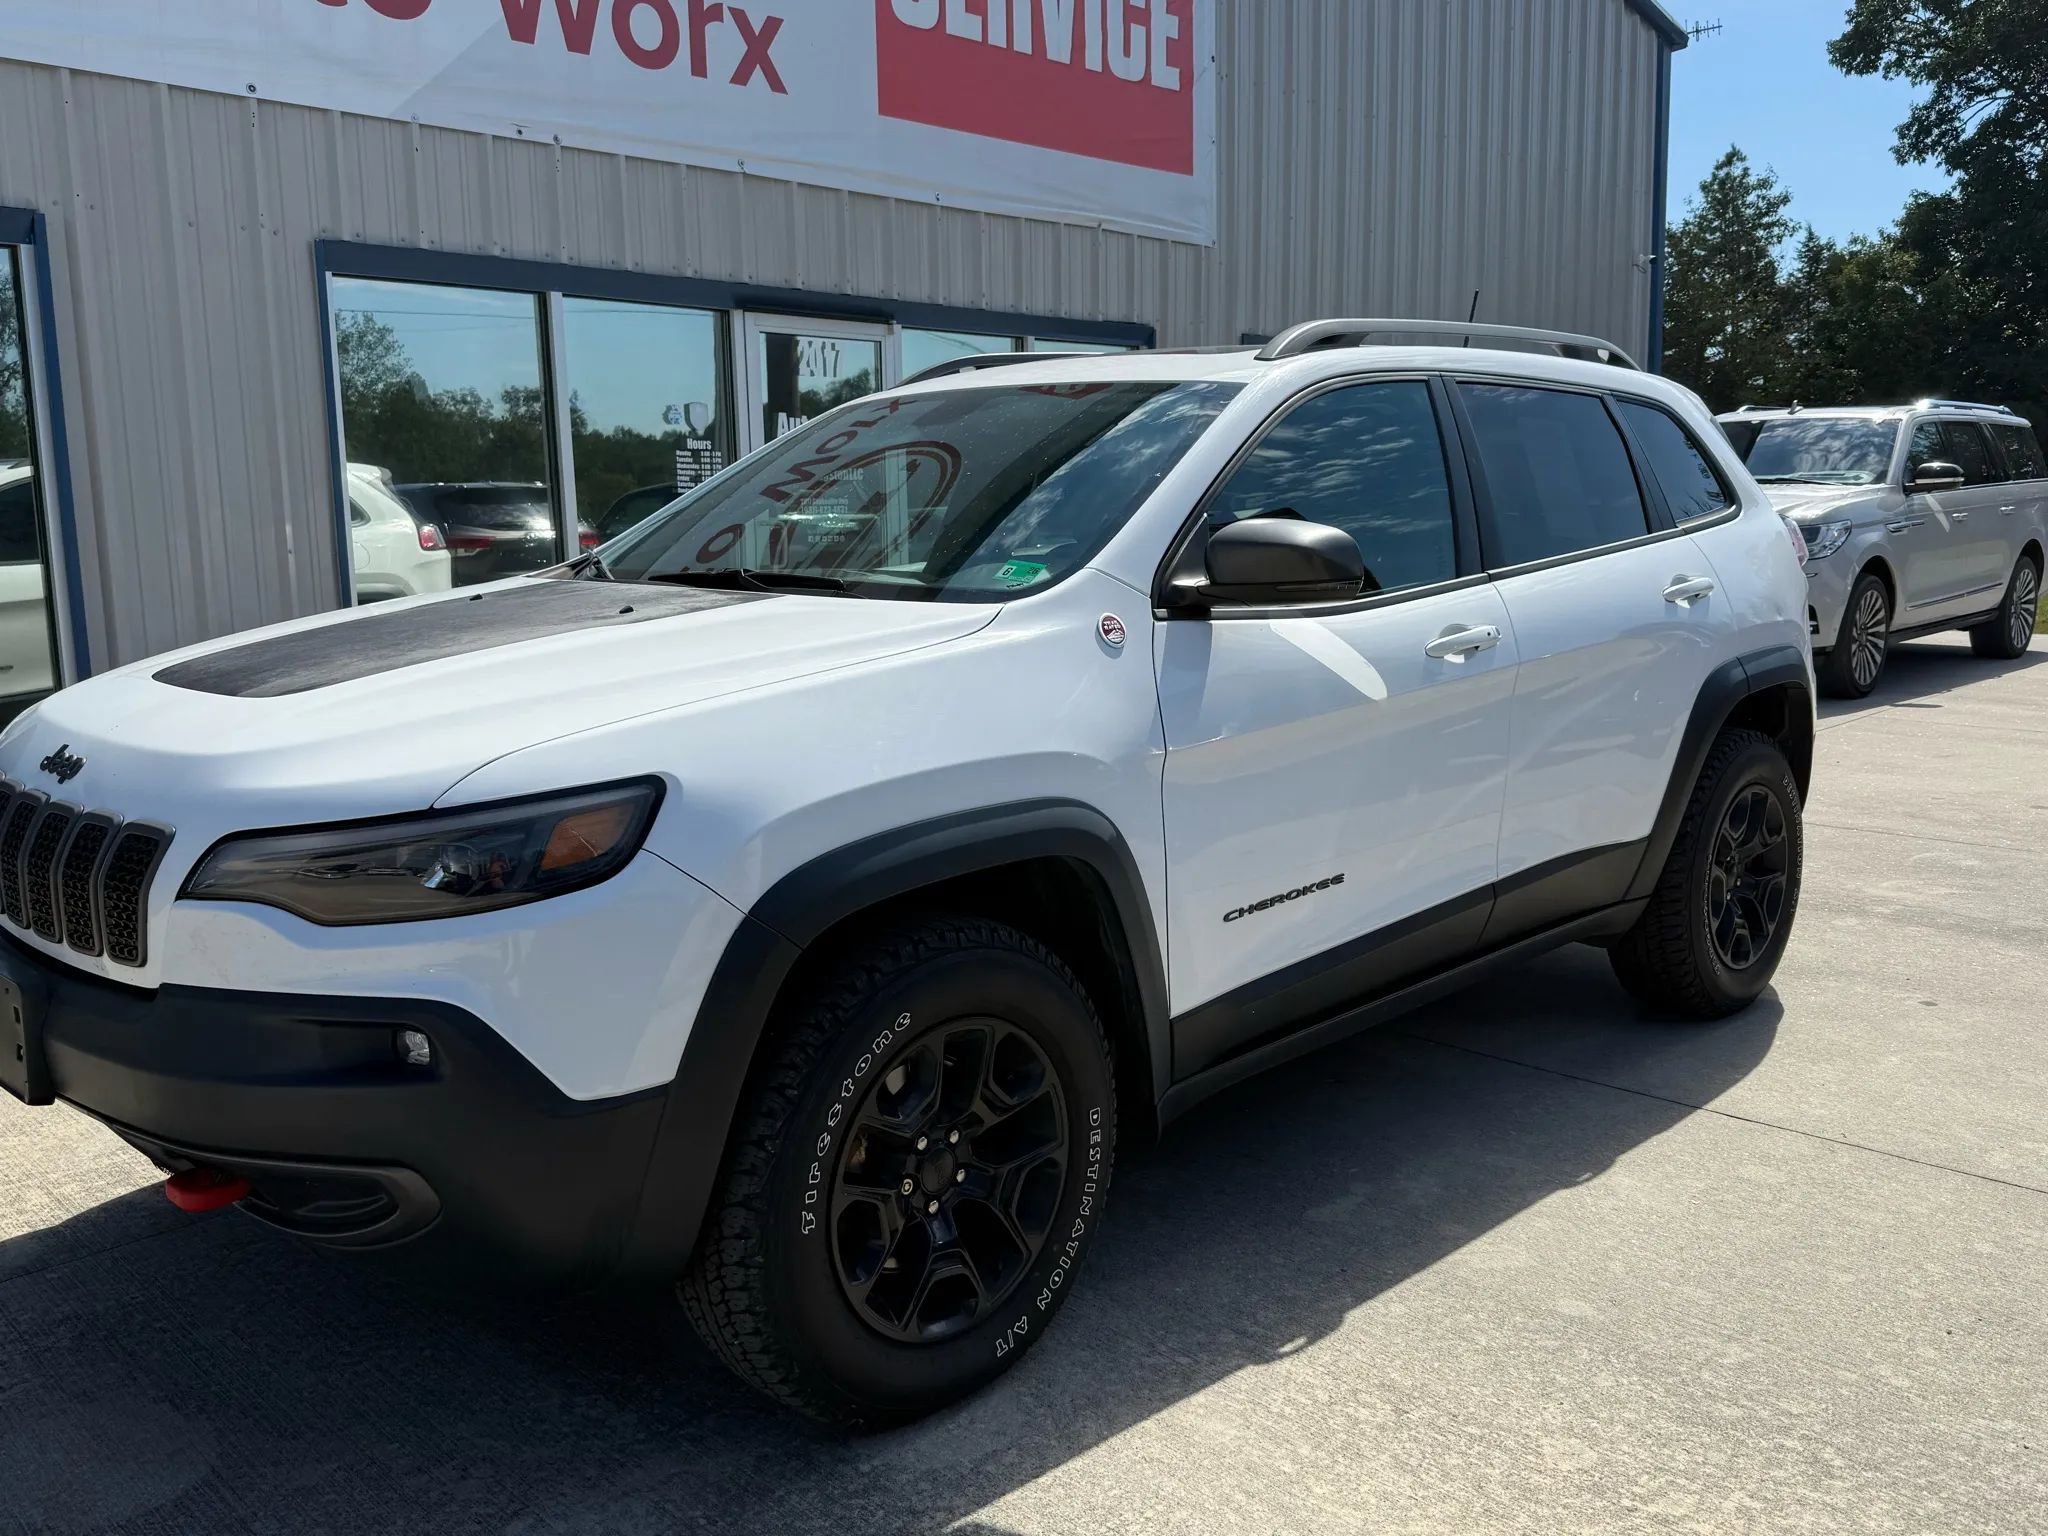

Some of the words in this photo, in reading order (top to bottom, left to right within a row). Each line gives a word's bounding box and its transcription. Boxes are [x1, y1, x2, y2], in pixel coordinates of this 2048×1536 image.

[797, 338, 840, 378] 2017
[687, 438, 711, 449] Hours
[1002, 567, 1013, 576] 6
[40, 744, 87, 784] Jeep
[1223, 873, 1345, 922] CHEROKEE
[1037, 1107, 1101, 1310] DESTINATION
[995, 1316, 1028, 1358] A/T
